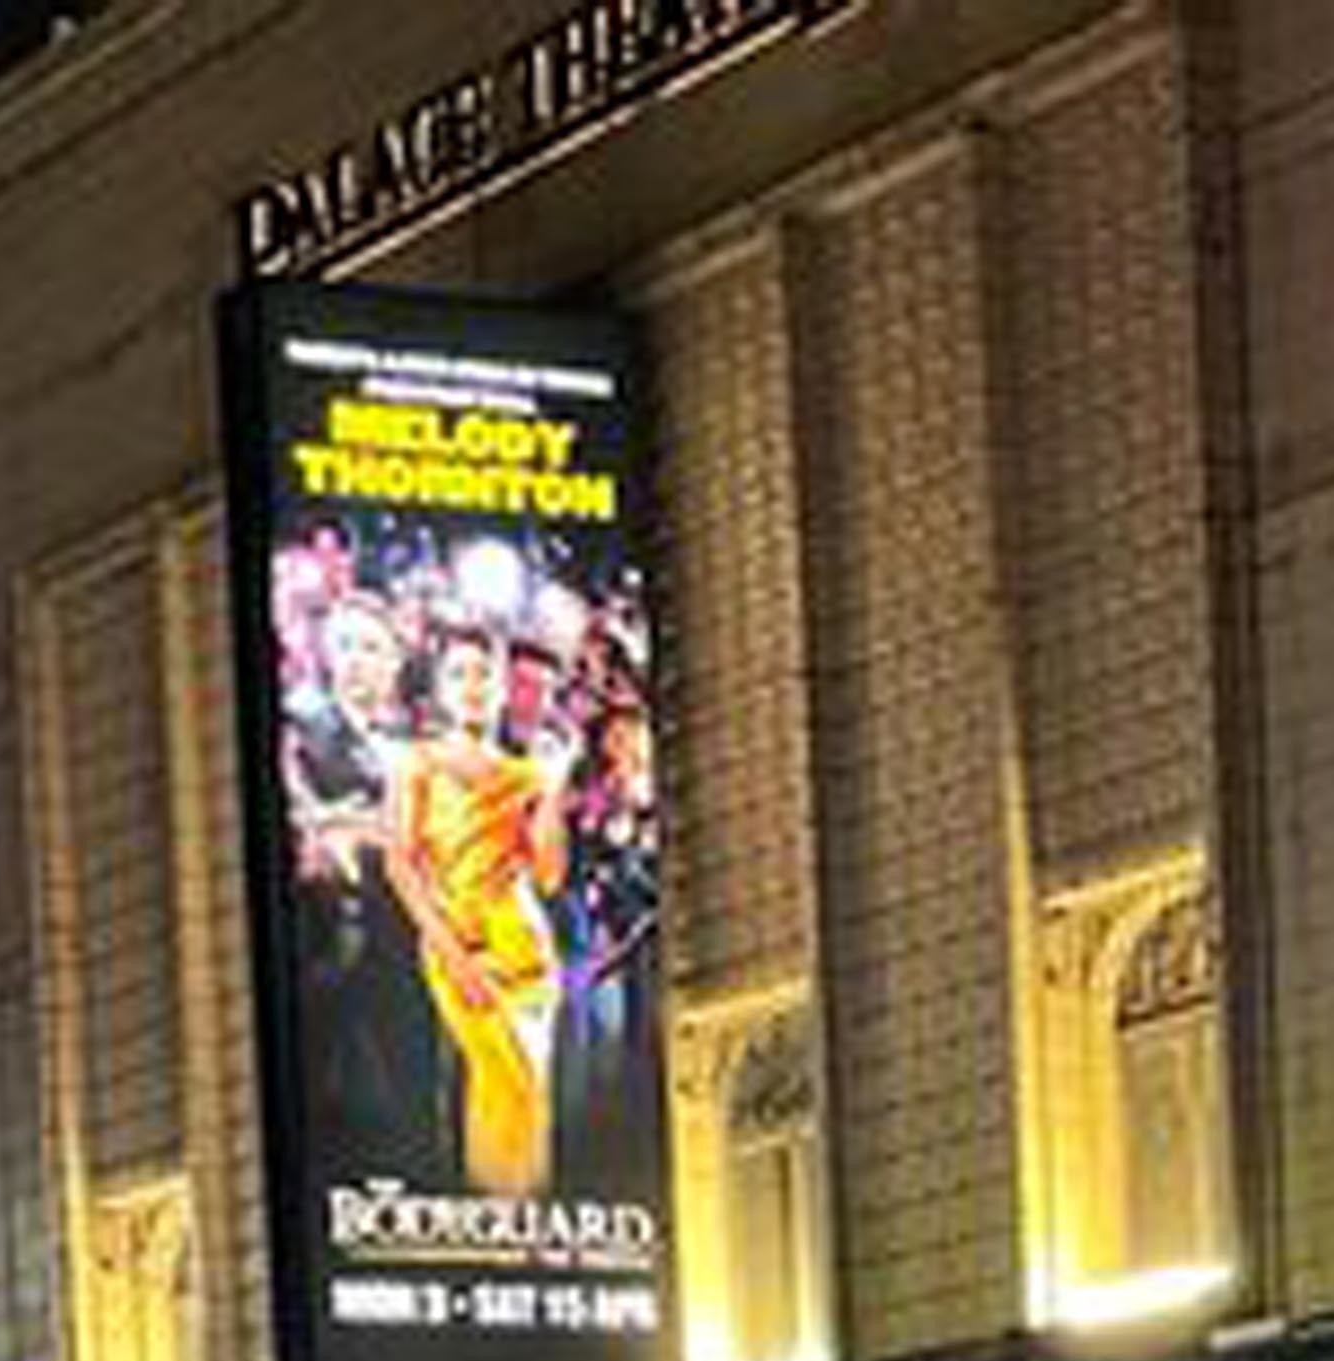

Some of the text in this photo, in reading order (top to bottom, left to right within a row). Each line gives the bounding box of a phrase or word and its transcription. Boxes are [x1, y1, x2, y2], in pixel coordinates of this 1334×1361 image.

[329, 400, 575, 464] MELODY
[293, 444, 615, 520] THORNTON
[328, 1186, 654, 1247] BODYGUARD
